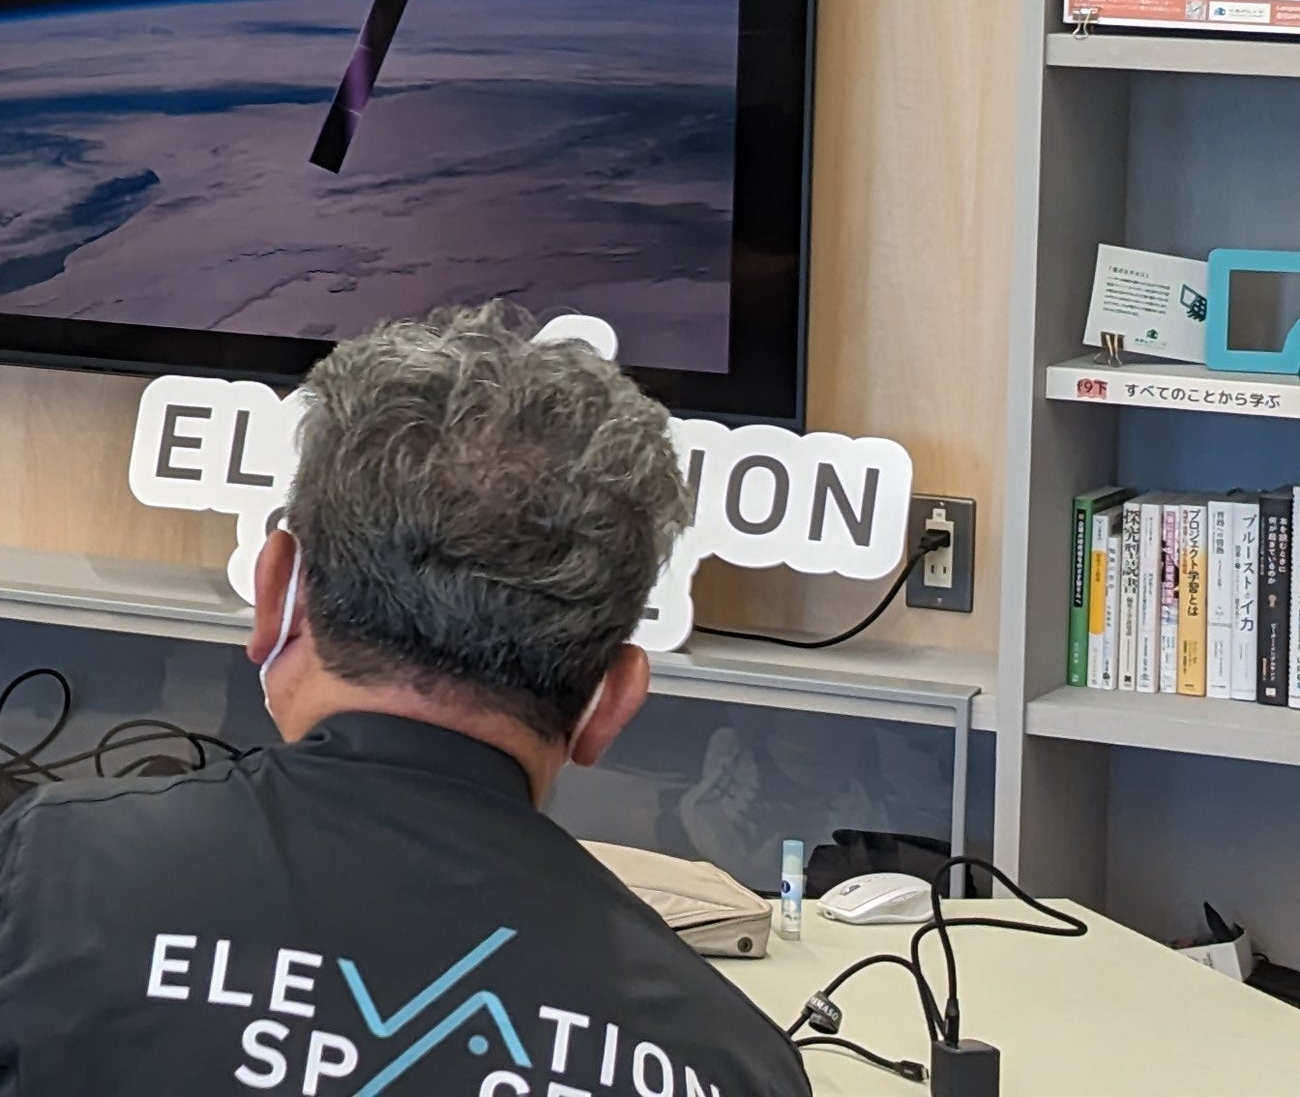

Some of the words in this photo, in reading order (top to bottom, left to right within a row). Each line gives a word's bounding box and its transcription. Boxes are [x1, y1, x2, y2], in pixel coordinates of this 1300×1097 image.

[1124, 382, 1282, 409] すべてのことから学ぶ
[155, 403, 881, 548] ELION
[1187, 509, 1202, 617] プロジェクト学習とは
